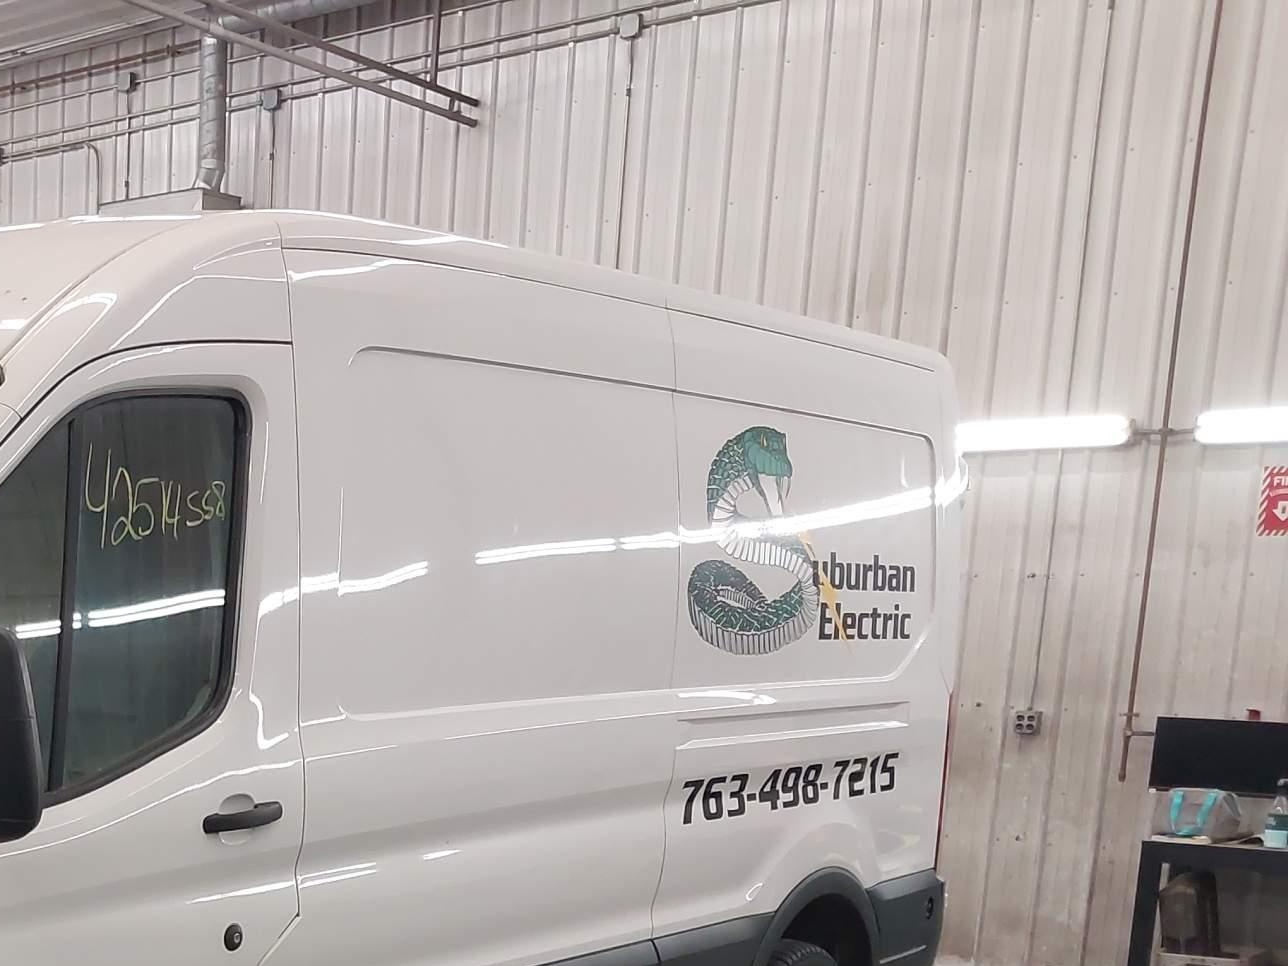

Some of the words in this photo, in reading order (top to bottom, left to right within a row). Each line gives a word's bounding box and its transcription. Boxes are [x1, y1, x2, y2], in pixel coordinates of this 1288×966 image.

[85, 441, 226, 550] 42514558
[818, 602, 912, 640] Electric
[682, 752, 900, 825] 763-498-7215
